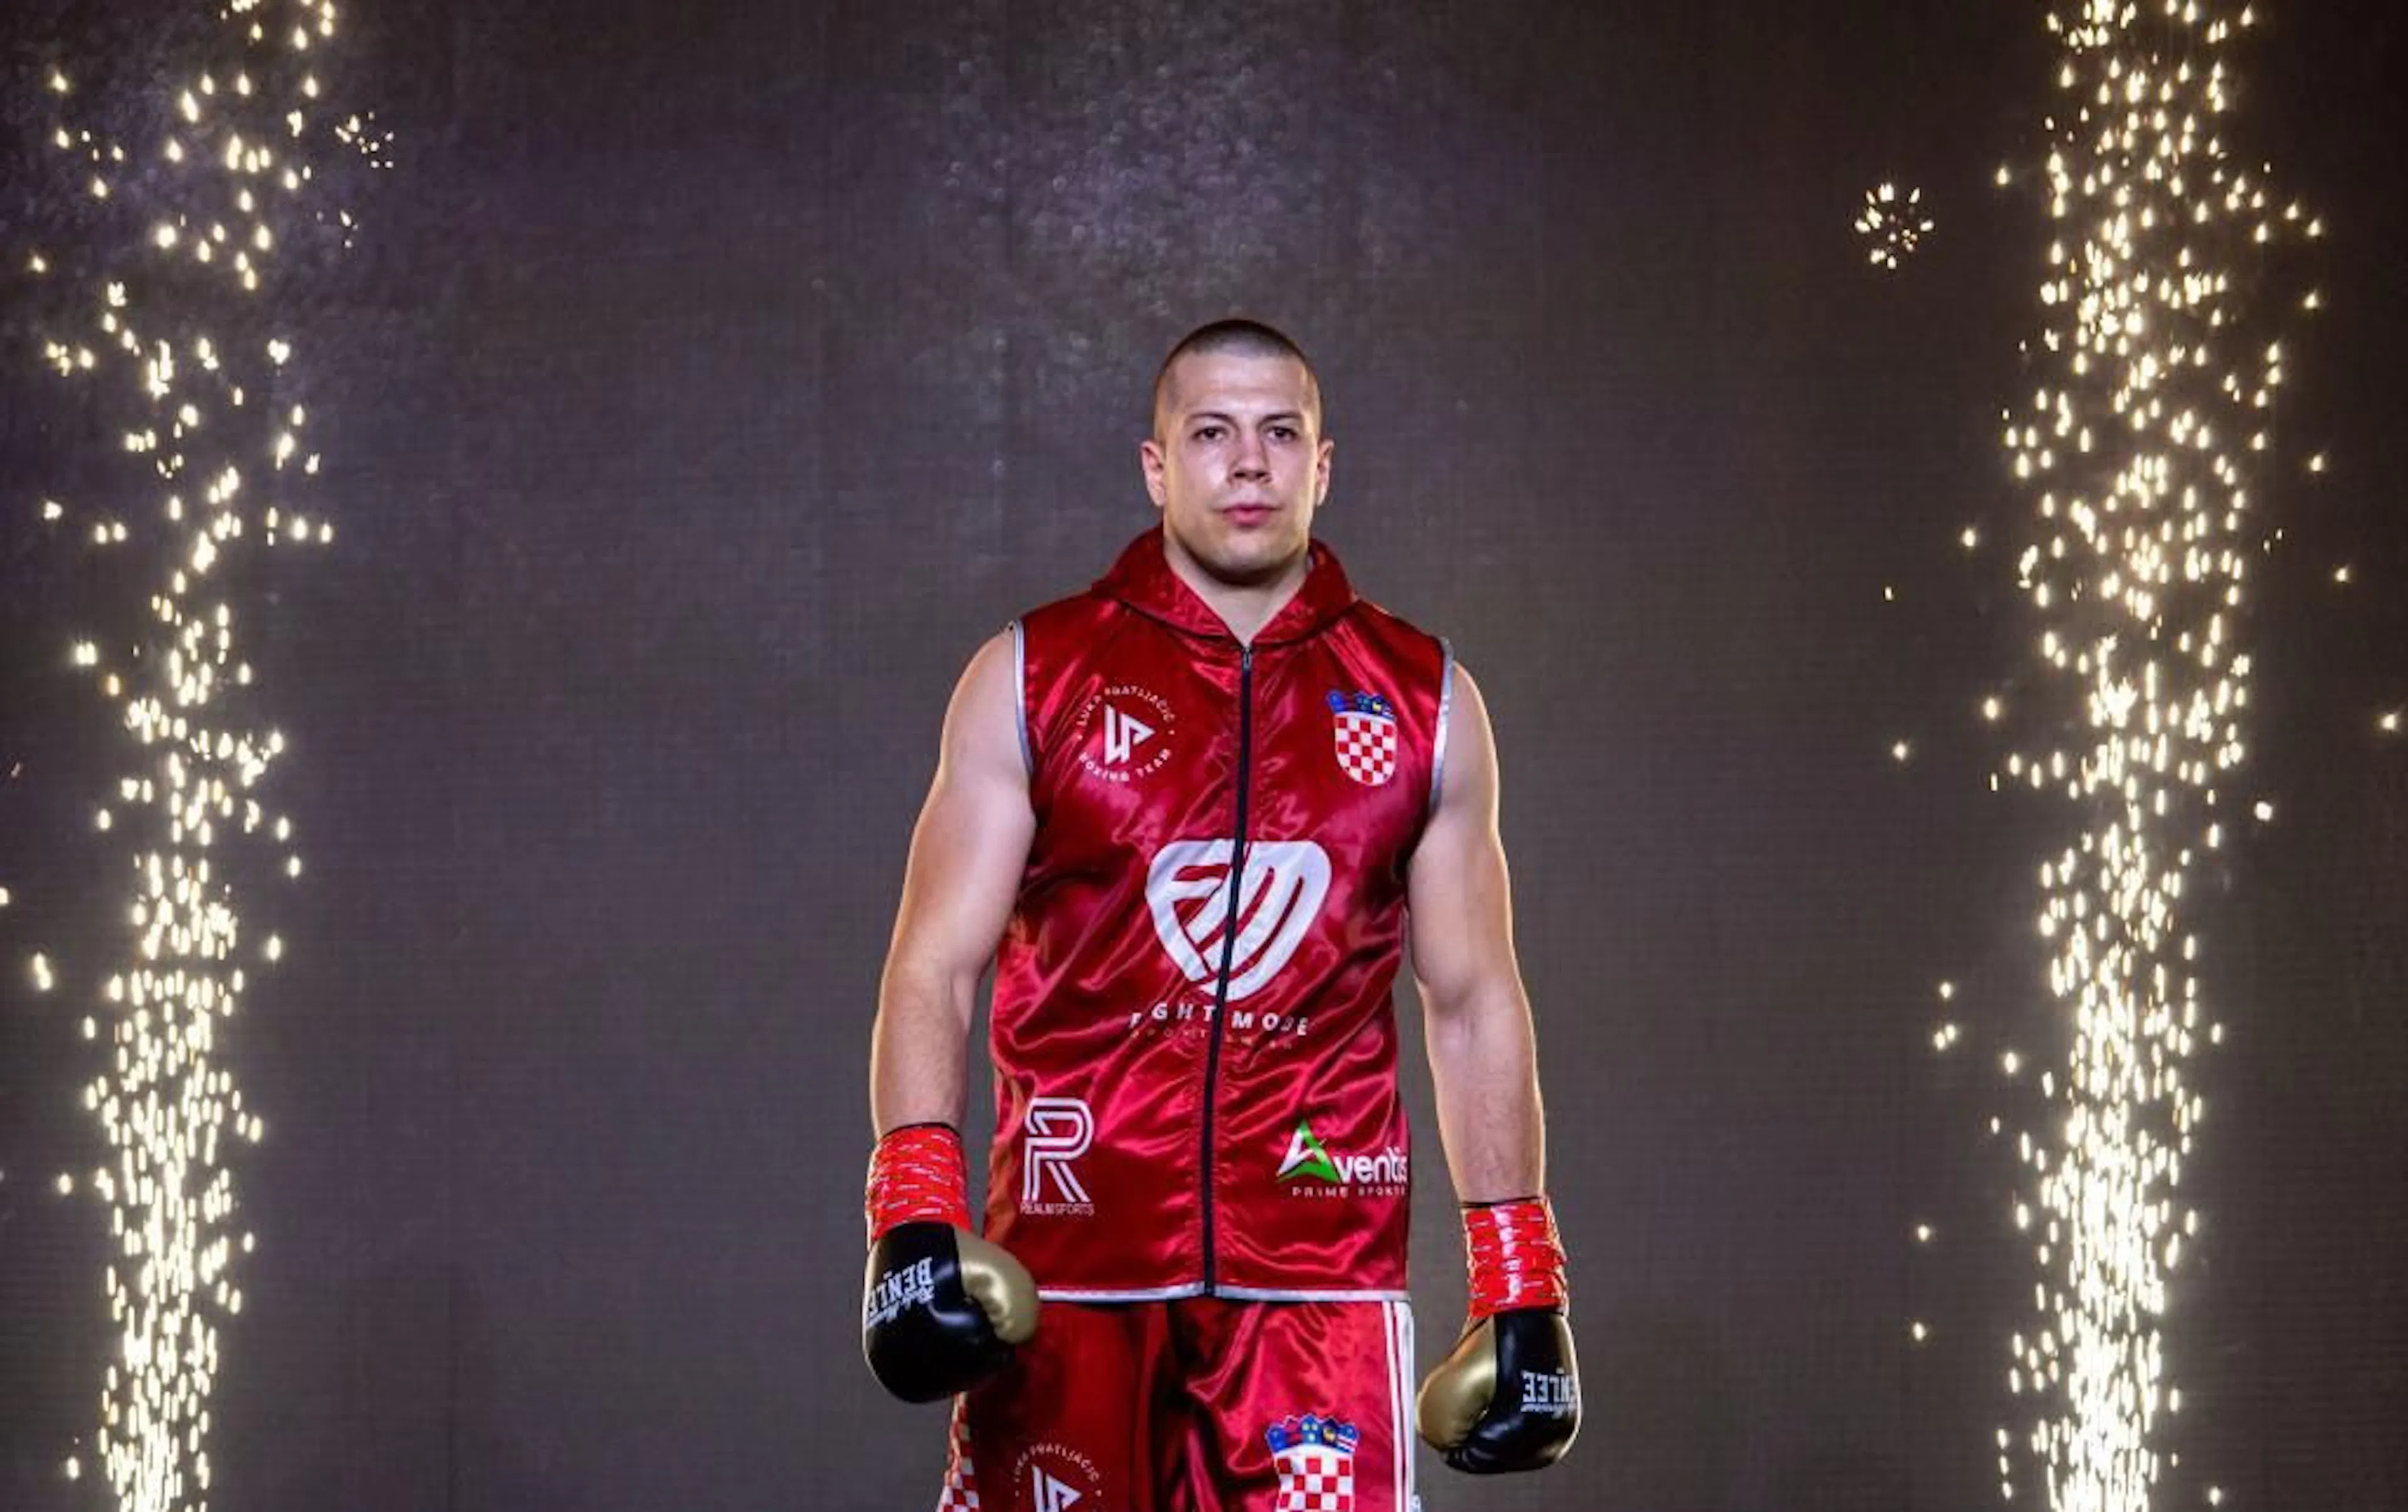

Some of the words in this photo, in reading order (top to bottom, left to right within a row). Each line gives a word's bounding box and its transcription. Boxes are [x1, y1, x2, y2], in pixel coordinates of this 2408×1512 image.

[1078, 752, 1130, 782] BOXING
[1135, 748, 1171, 778] TEAM
[1129, 1003, 1217, 1027] FGHT
[1292, 1186, 1349, 1198] PRIME
